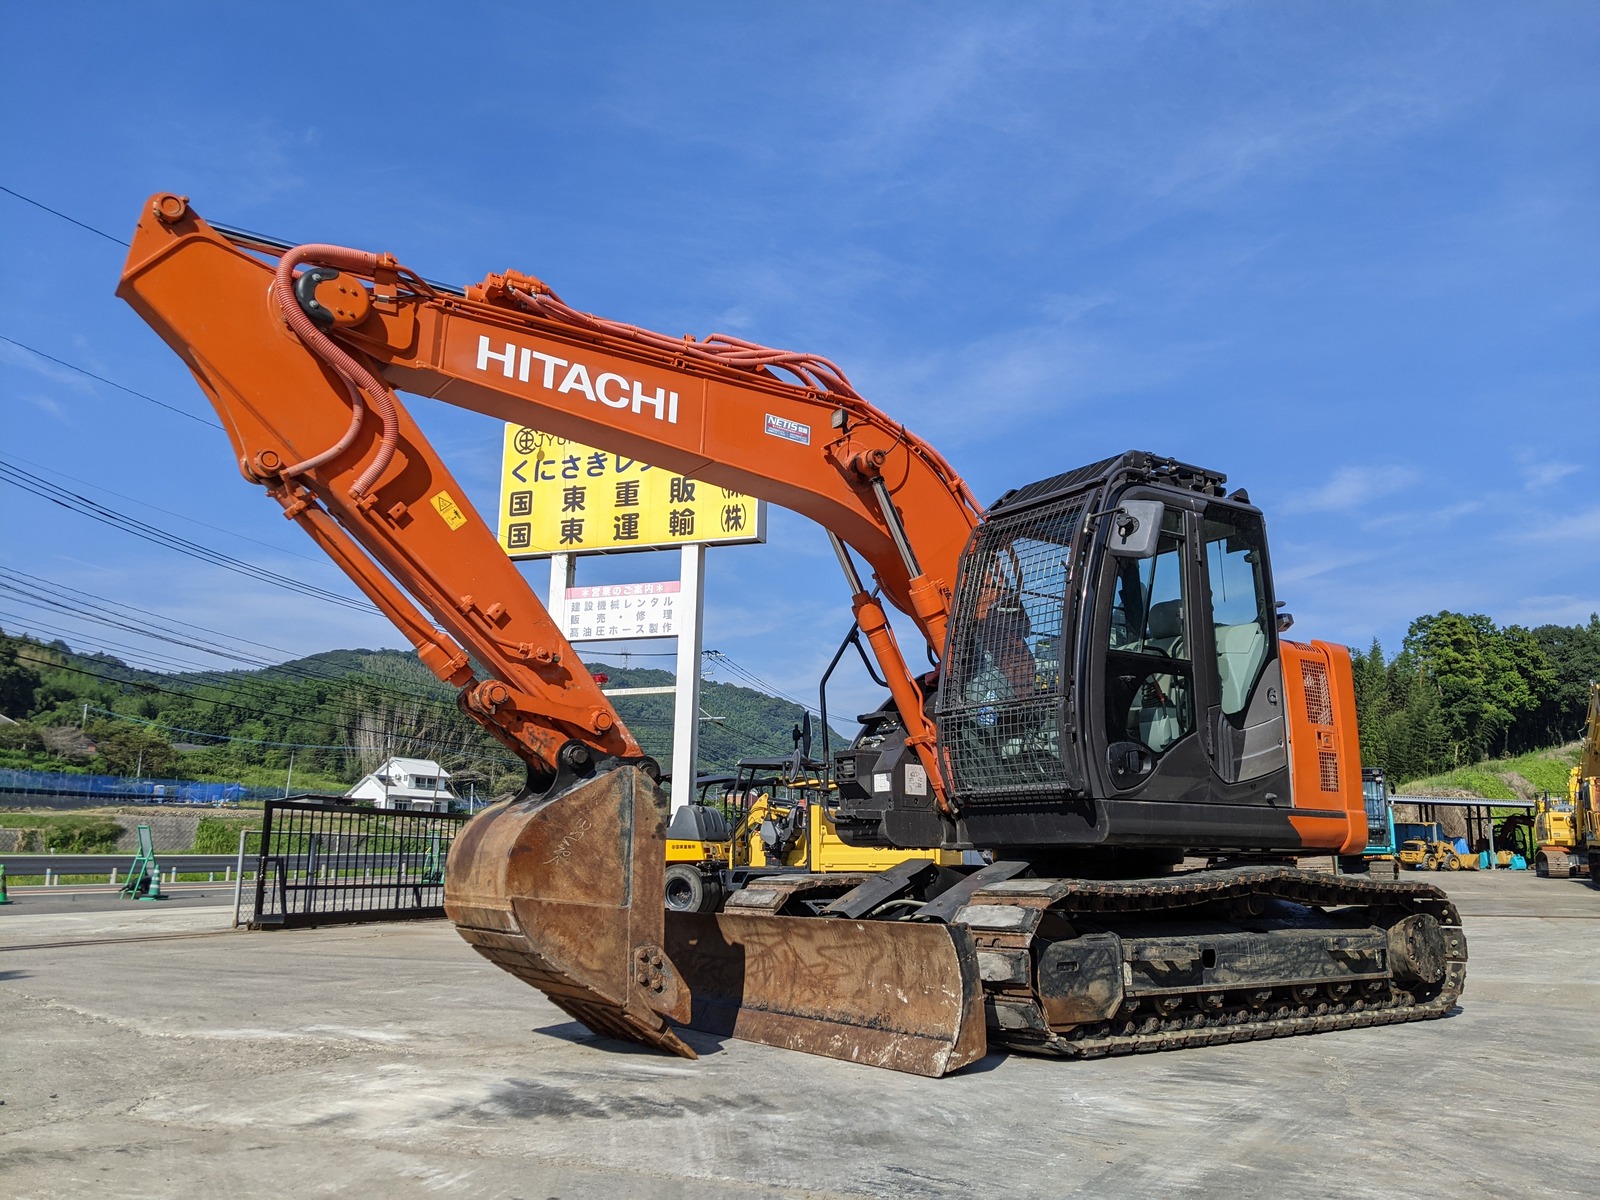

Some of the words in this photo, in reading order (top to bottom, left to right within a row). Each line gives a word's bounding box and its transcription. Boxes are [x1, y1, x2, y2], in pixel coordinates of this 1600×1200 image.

[476, 335, 679, 424] HITACHI
[768, 416, 798, 431] NETIS
[512, 450, 651, 483] くにさきレ
[507, 503, 747, 548] 国東運輸(株)
[571, 596, 673, 612] 建設機械レンタル
